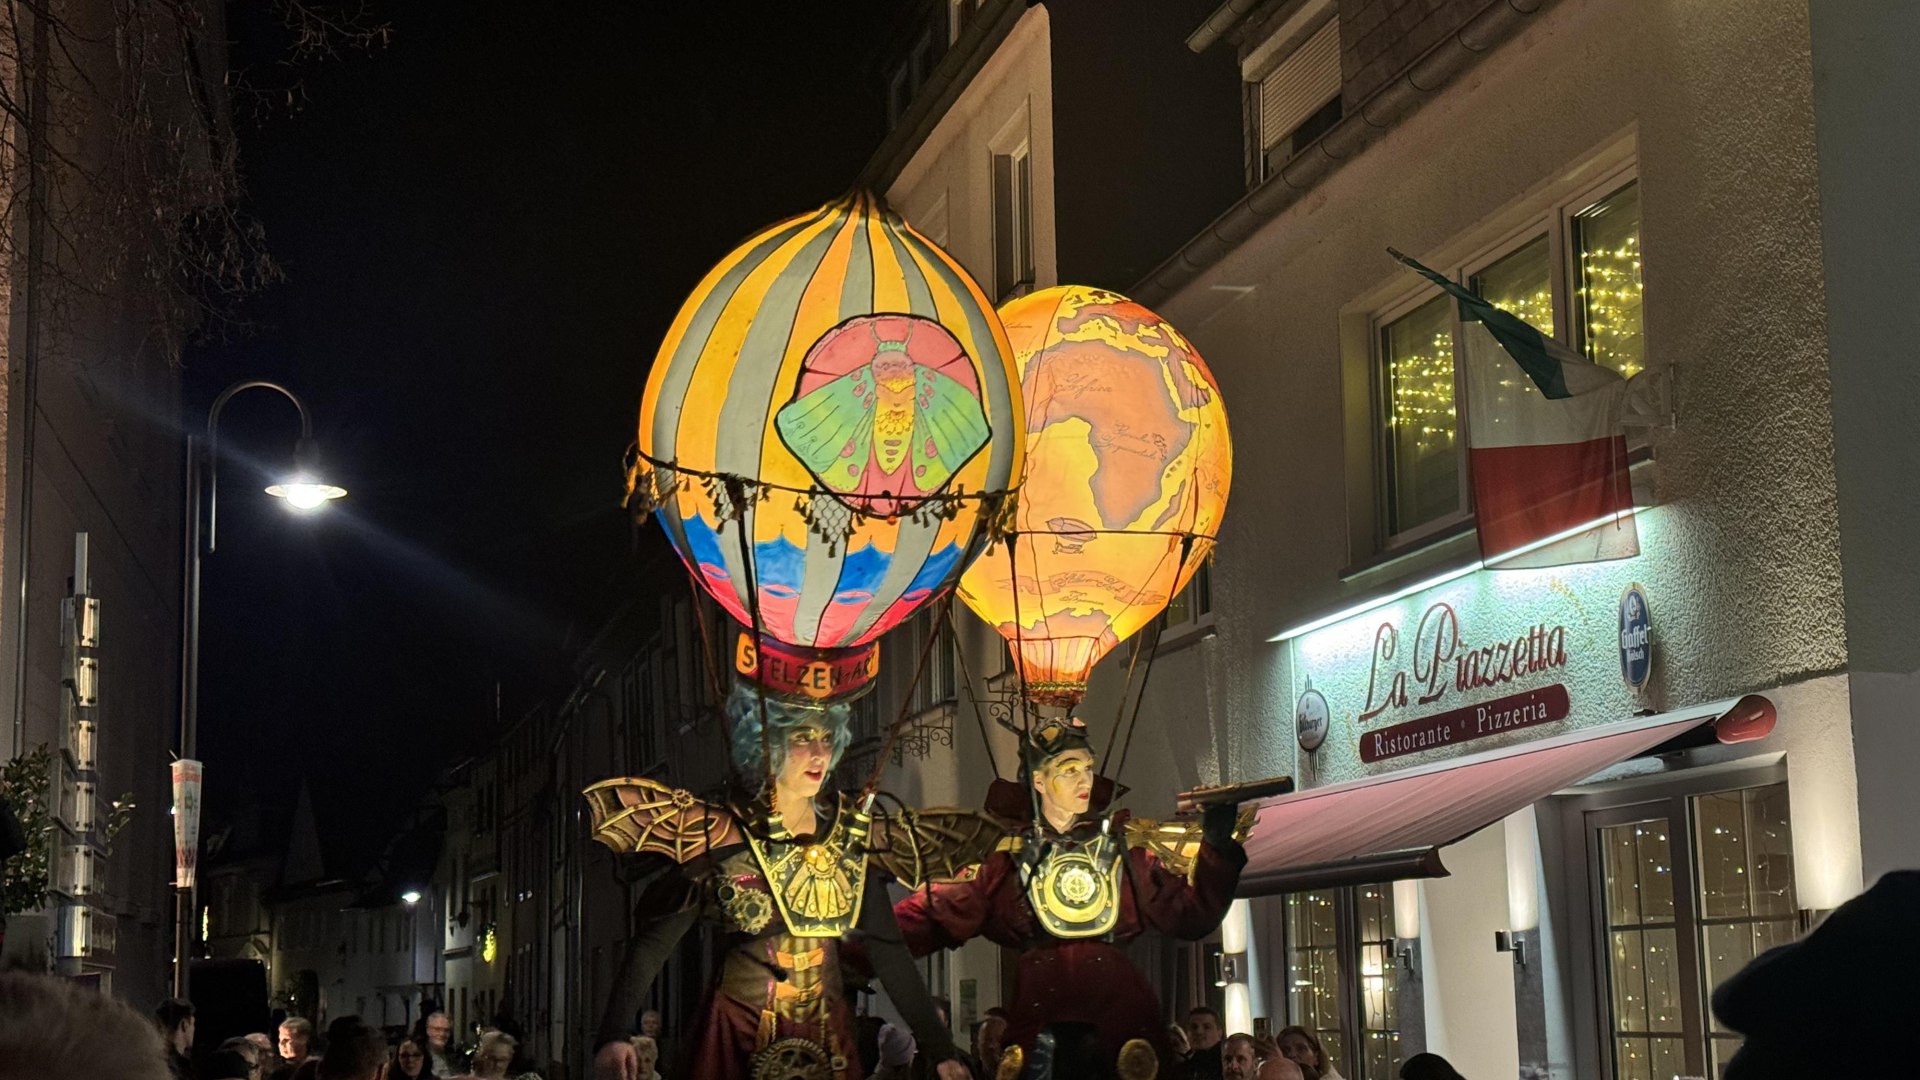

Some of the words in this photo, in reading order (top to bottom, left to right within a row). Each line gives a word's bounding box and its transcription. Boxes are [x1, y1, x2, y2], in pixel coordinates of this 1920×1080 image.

[1358, 622, 1407, 723] La
[1414, 602, 1568, 705] Piazzetta
[1621, 624, 1649, 650] Gaffel
[1374, 725, 1451, 757] Ristorante
[1477, 694, 1547, 734] Pizzeria
